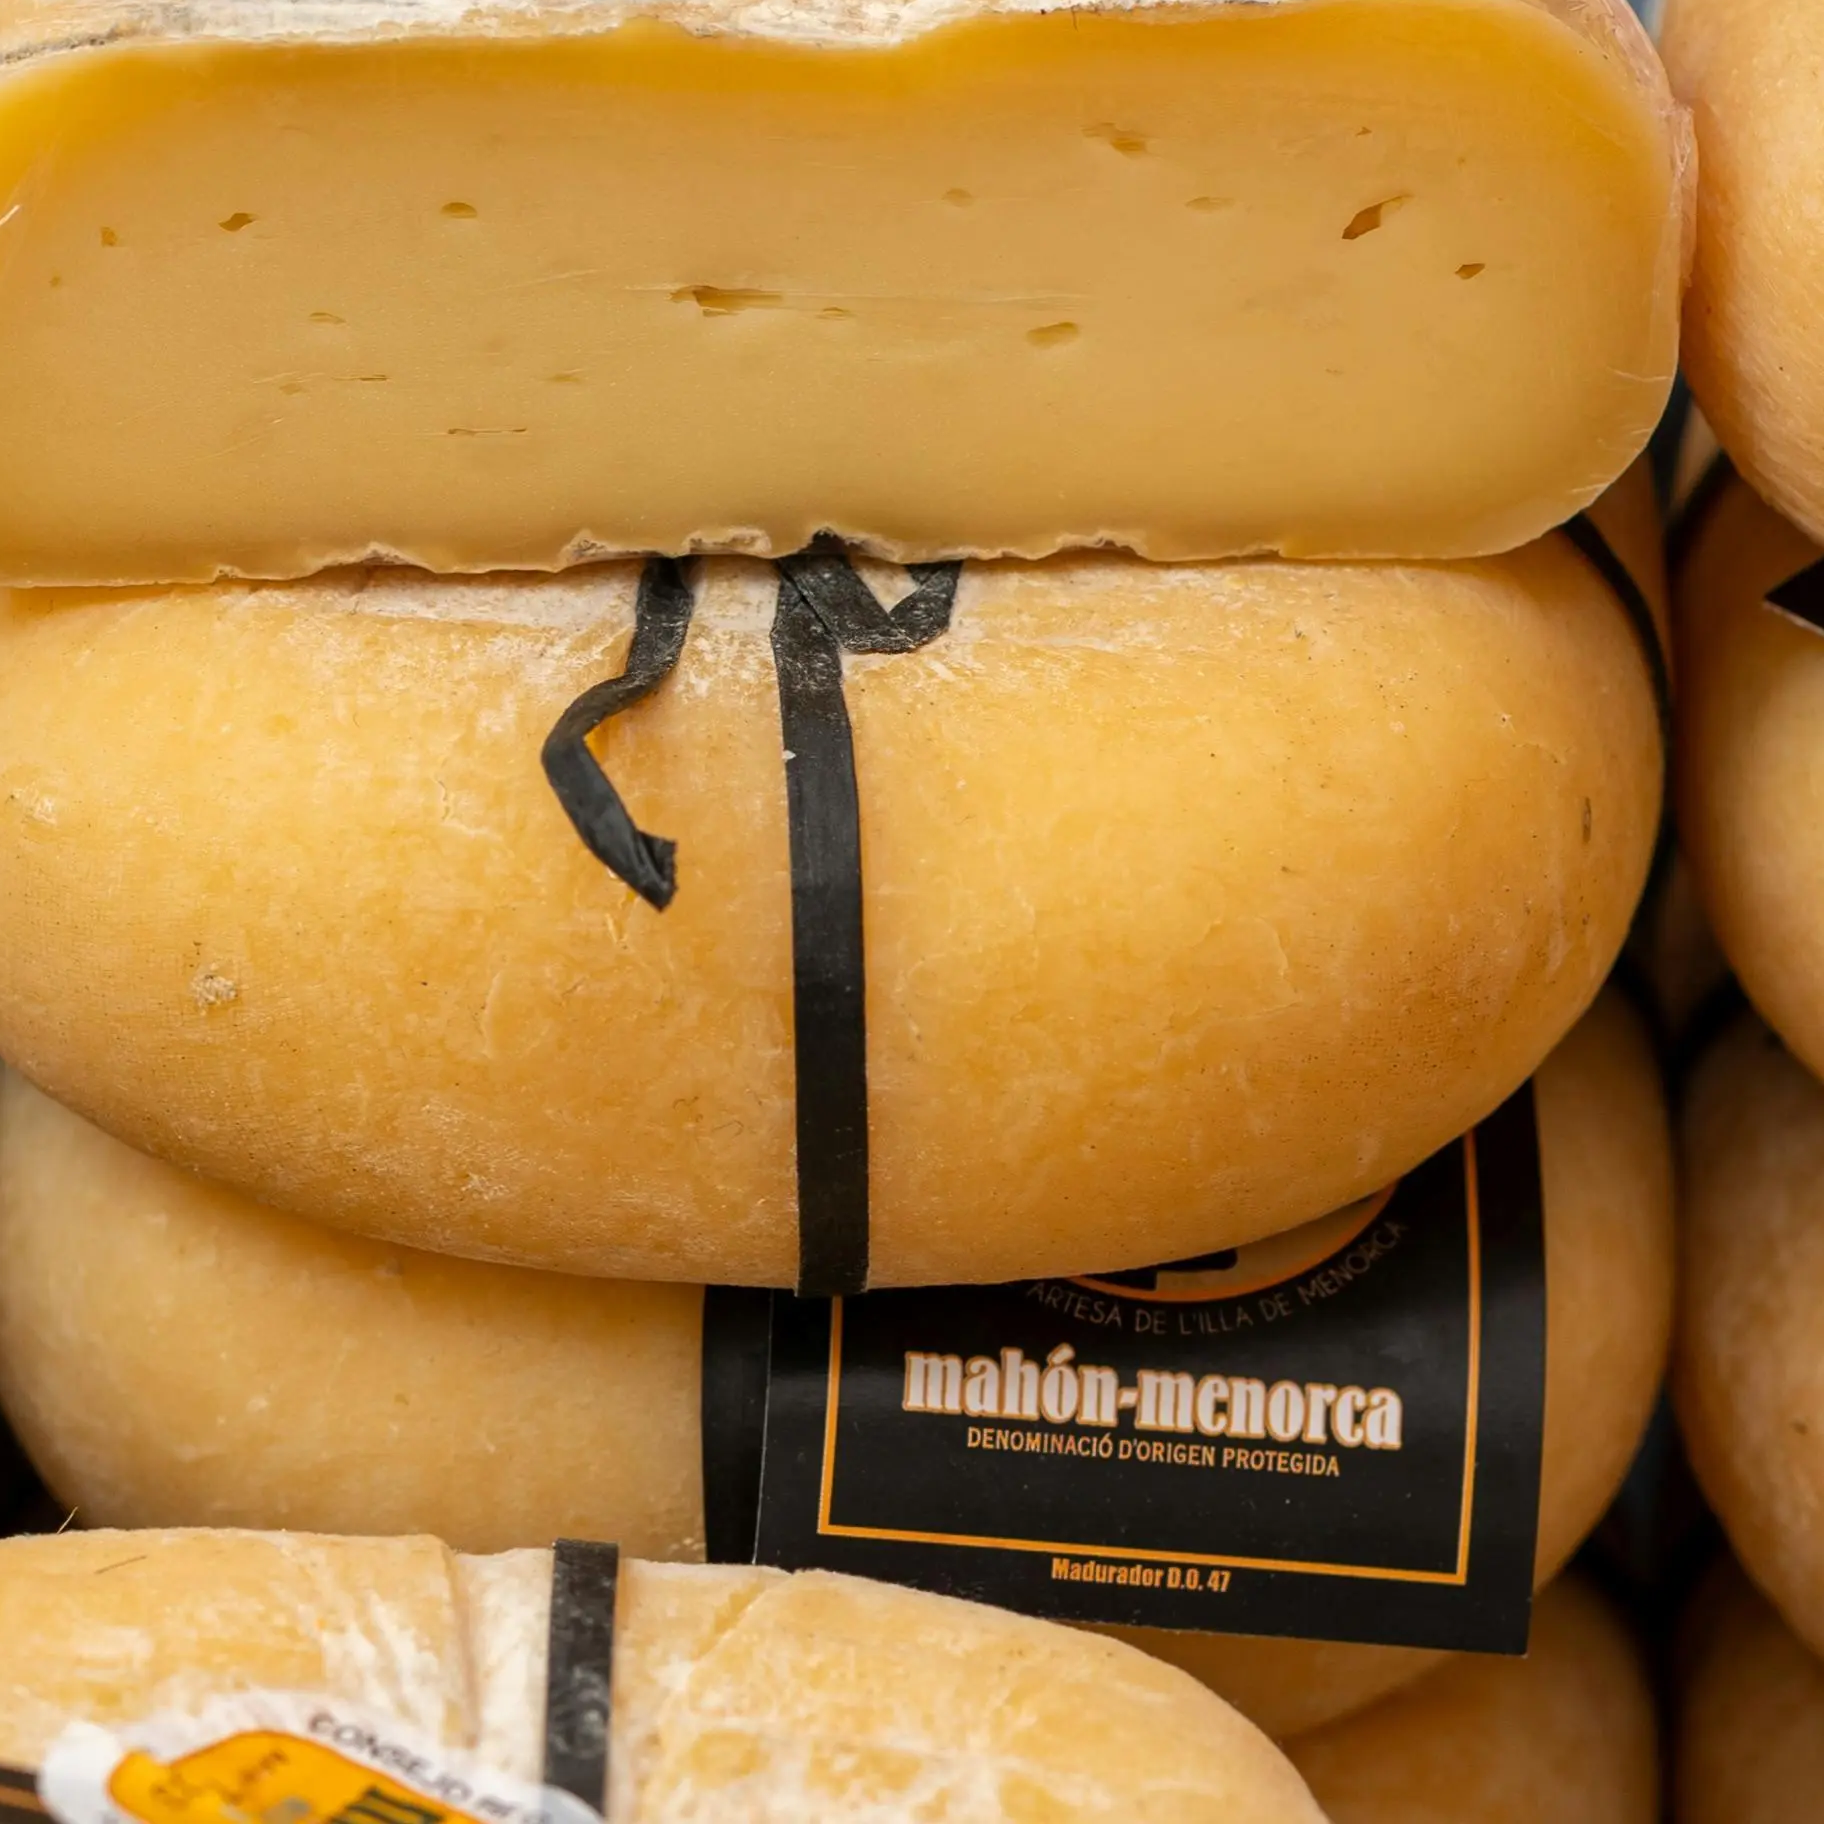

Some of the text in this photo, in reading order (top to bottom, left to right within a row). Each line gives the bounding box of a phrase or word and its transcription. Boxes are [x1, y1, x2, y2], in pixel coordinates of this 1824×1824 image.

[1134, 1308, 1168, 1336] DE
[1179, 1306, 1254, 1336] L'ILLA
[1263, 1297, 1294, 1324] DE
[1298, 1219, 1409, 1307] MENORCA
[901, 1342, 1404, 1451] mahón-menorca
[966, 1426, 1341, 1477] DENOMINACIÓ D'ORIGEN PROTEGIDA
[1050, 1557, 1232, 1593] Madurador D.O. 47
